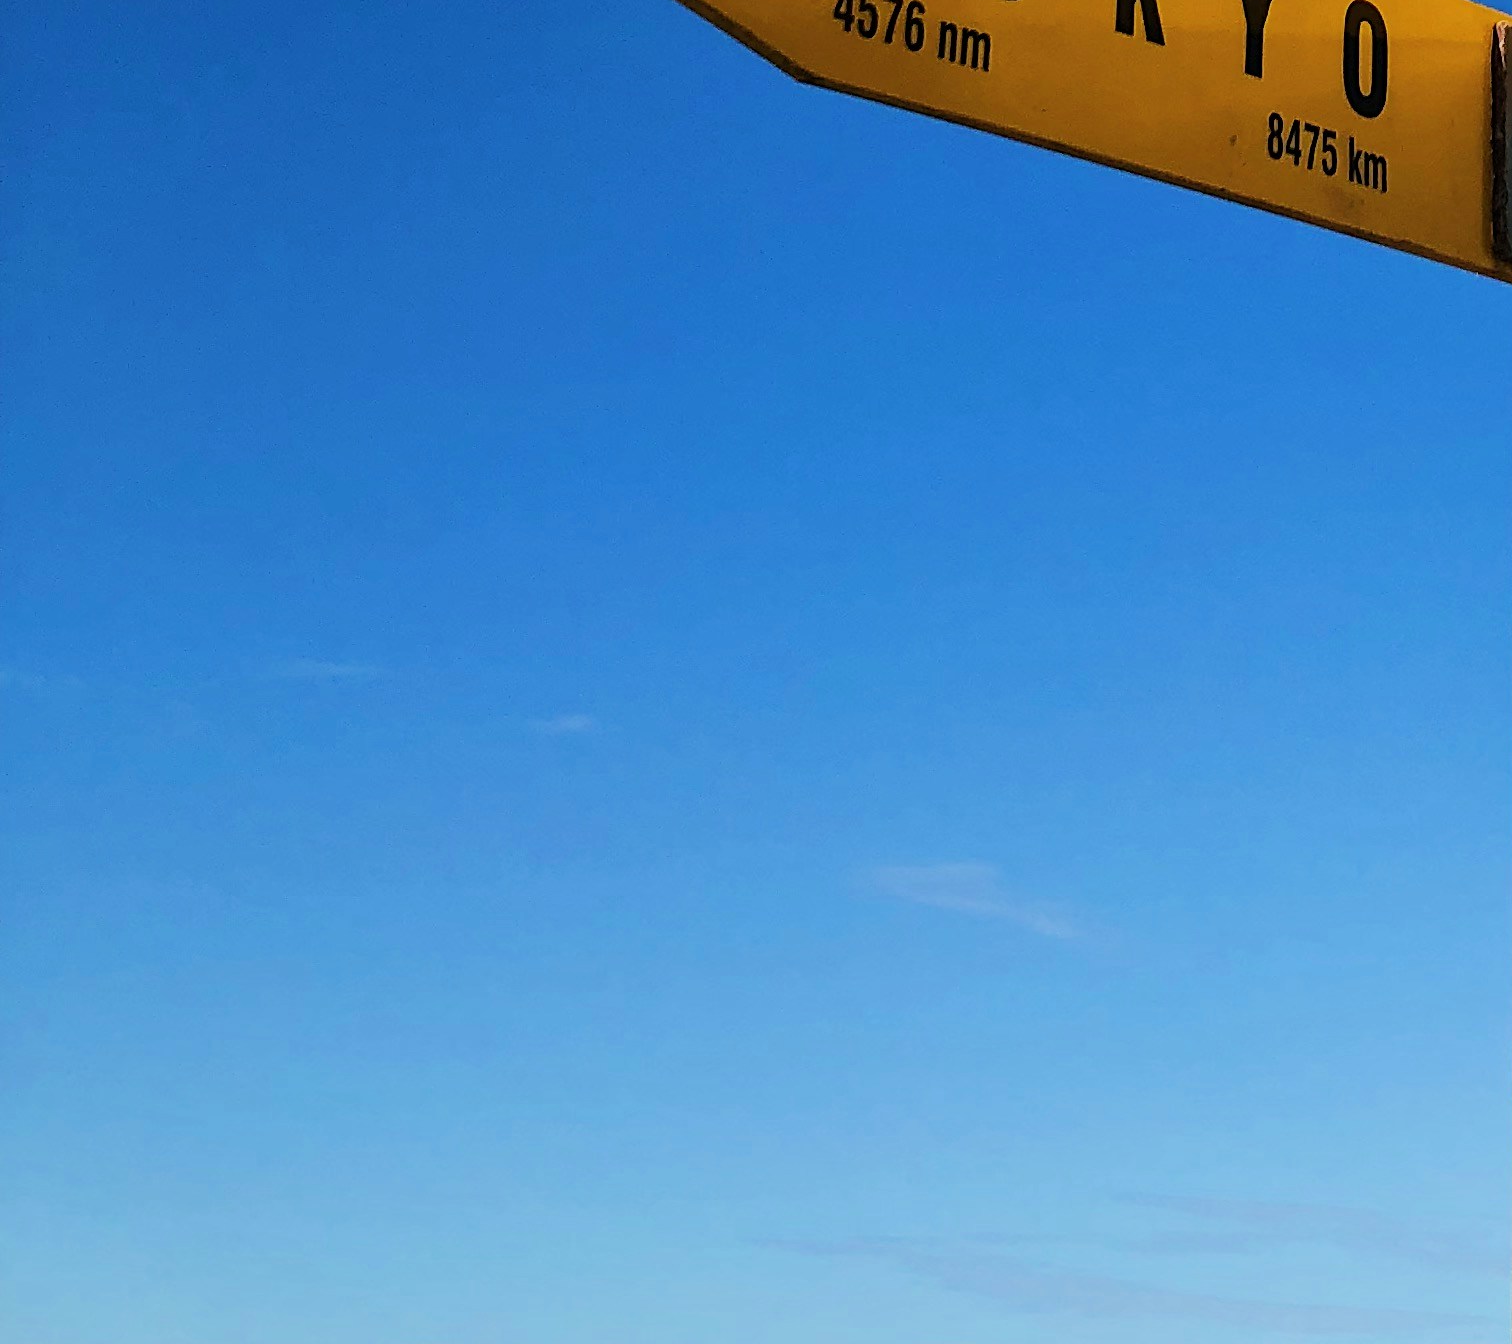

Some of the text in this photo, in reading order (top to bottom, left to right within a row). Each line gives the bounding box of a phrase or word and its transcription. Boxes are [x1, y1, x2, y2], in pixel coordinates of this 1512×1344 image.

[936, 19, 993, 73] nm
[1267, 112, 1389, 194] 8475 km
